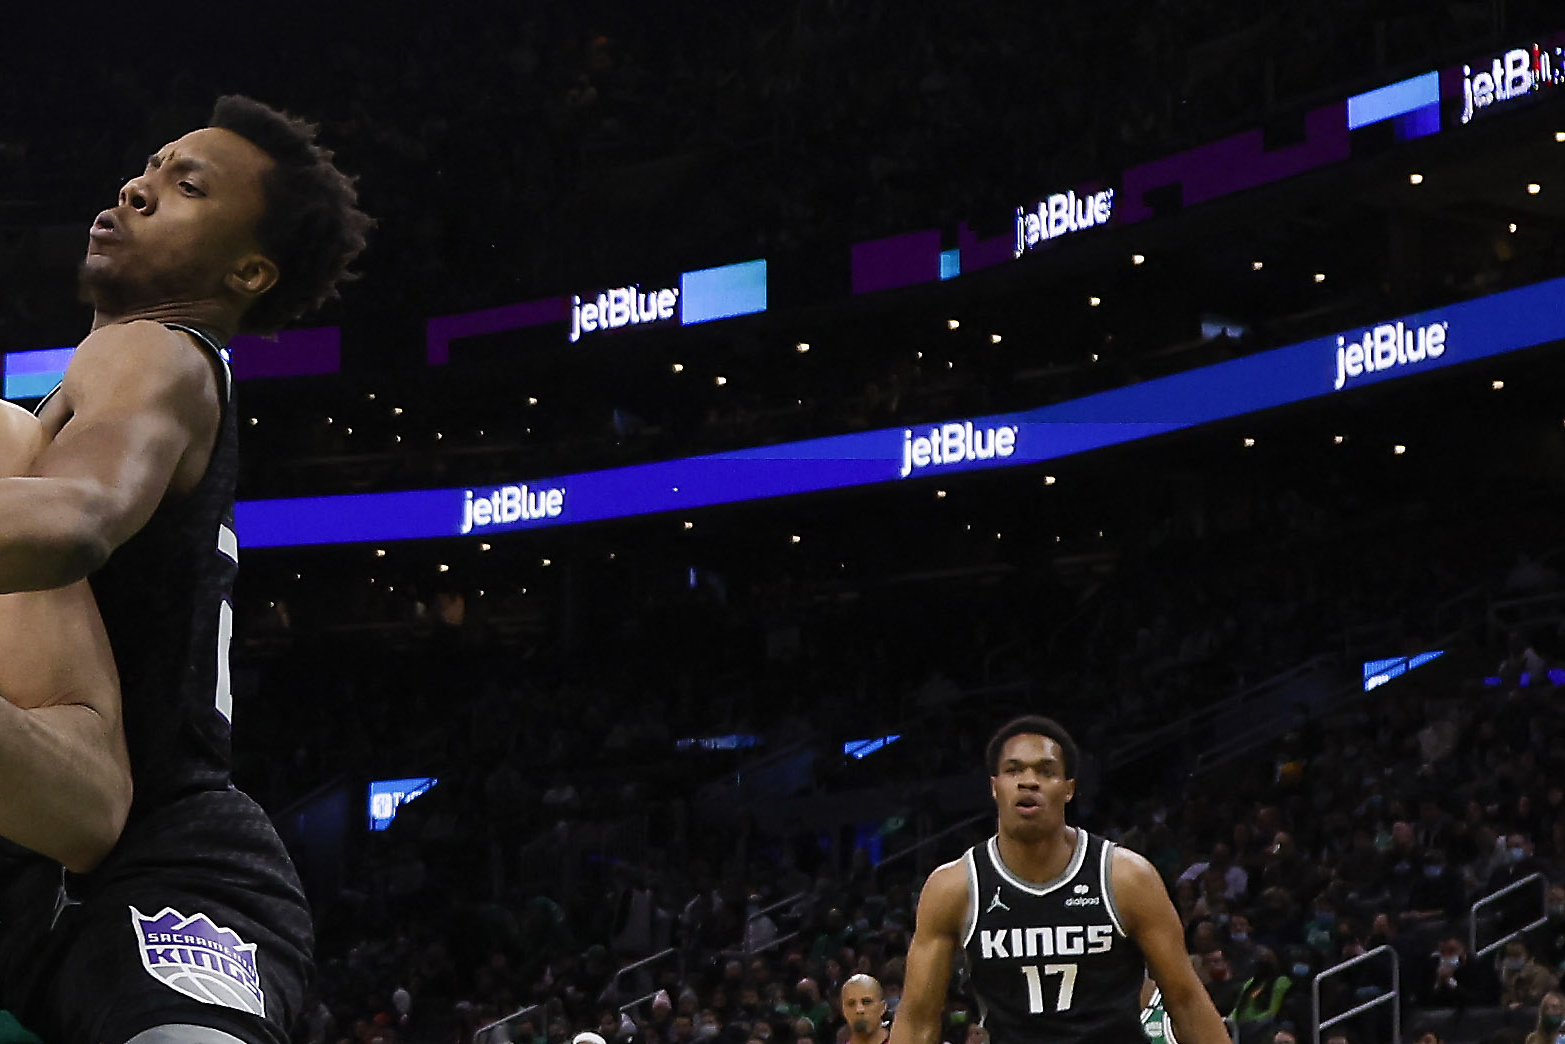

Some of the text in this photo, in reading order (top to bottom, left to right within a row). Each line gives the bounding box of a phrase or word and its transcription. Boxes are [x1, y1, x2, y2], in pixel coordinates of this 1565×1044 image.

[1015, 190, 1111, 258] jetBlue
[570, 286, 676, 342] jetBlue
[1335, 321, 1446, 389] jetBlue
[901, 421, 1015, 477] jetBlue
[462, 484, 563, 533] jetBlue
[981, 925, 1113, 959] KINGS
[1021, 963, 1078, 1014] 17
